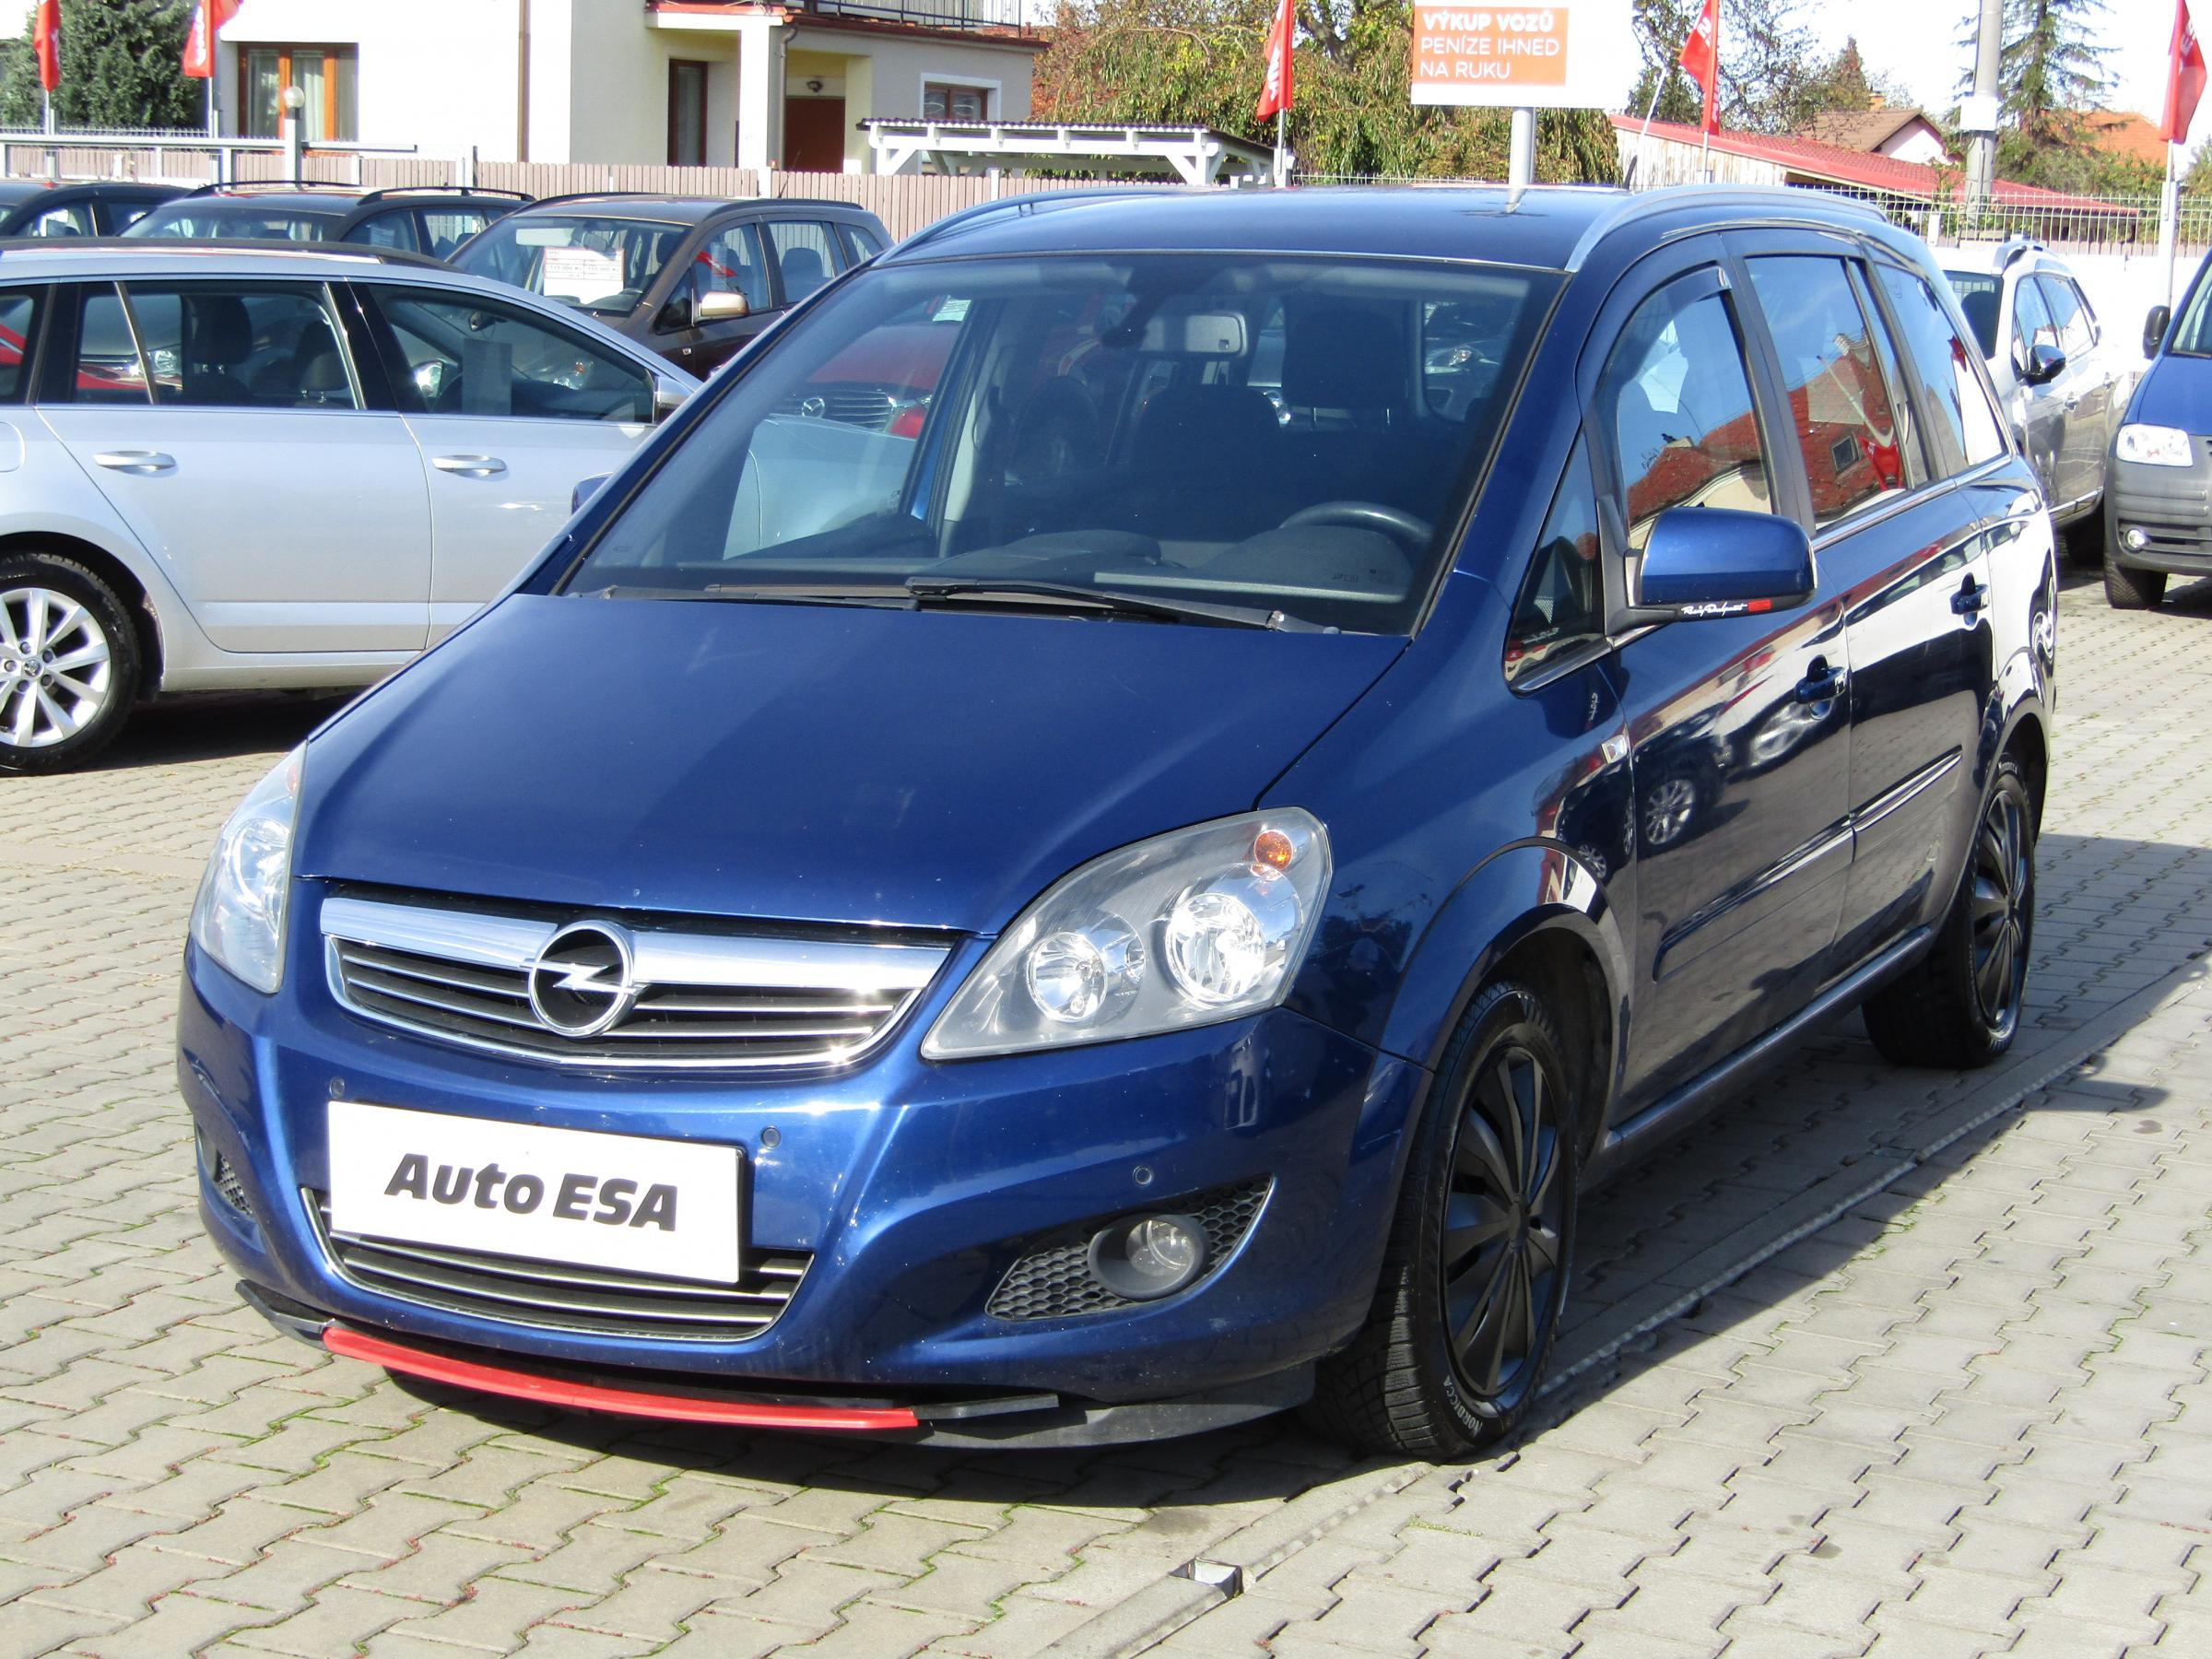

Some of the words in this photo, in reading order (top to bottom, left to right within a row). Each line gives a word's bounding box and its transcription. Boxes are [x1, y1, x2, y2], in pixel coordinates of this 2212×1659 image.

[1424, 10, 1490, 30] VÝKUP
[1497, 9, 1554, 31] VOZŮ
[1421, 35, 1490, 55] PENÍZE
[1498, 39, 1559, 56] IHNED
[1421, 62, 1448, 77] NA
[1455, 62, 1511, 78] RUKU
[383, 1153, 545, 1215] Auto
[552, 1172, 677, 1232] ESA
[1443, 1376, 1483, 1437] NORDICCA
